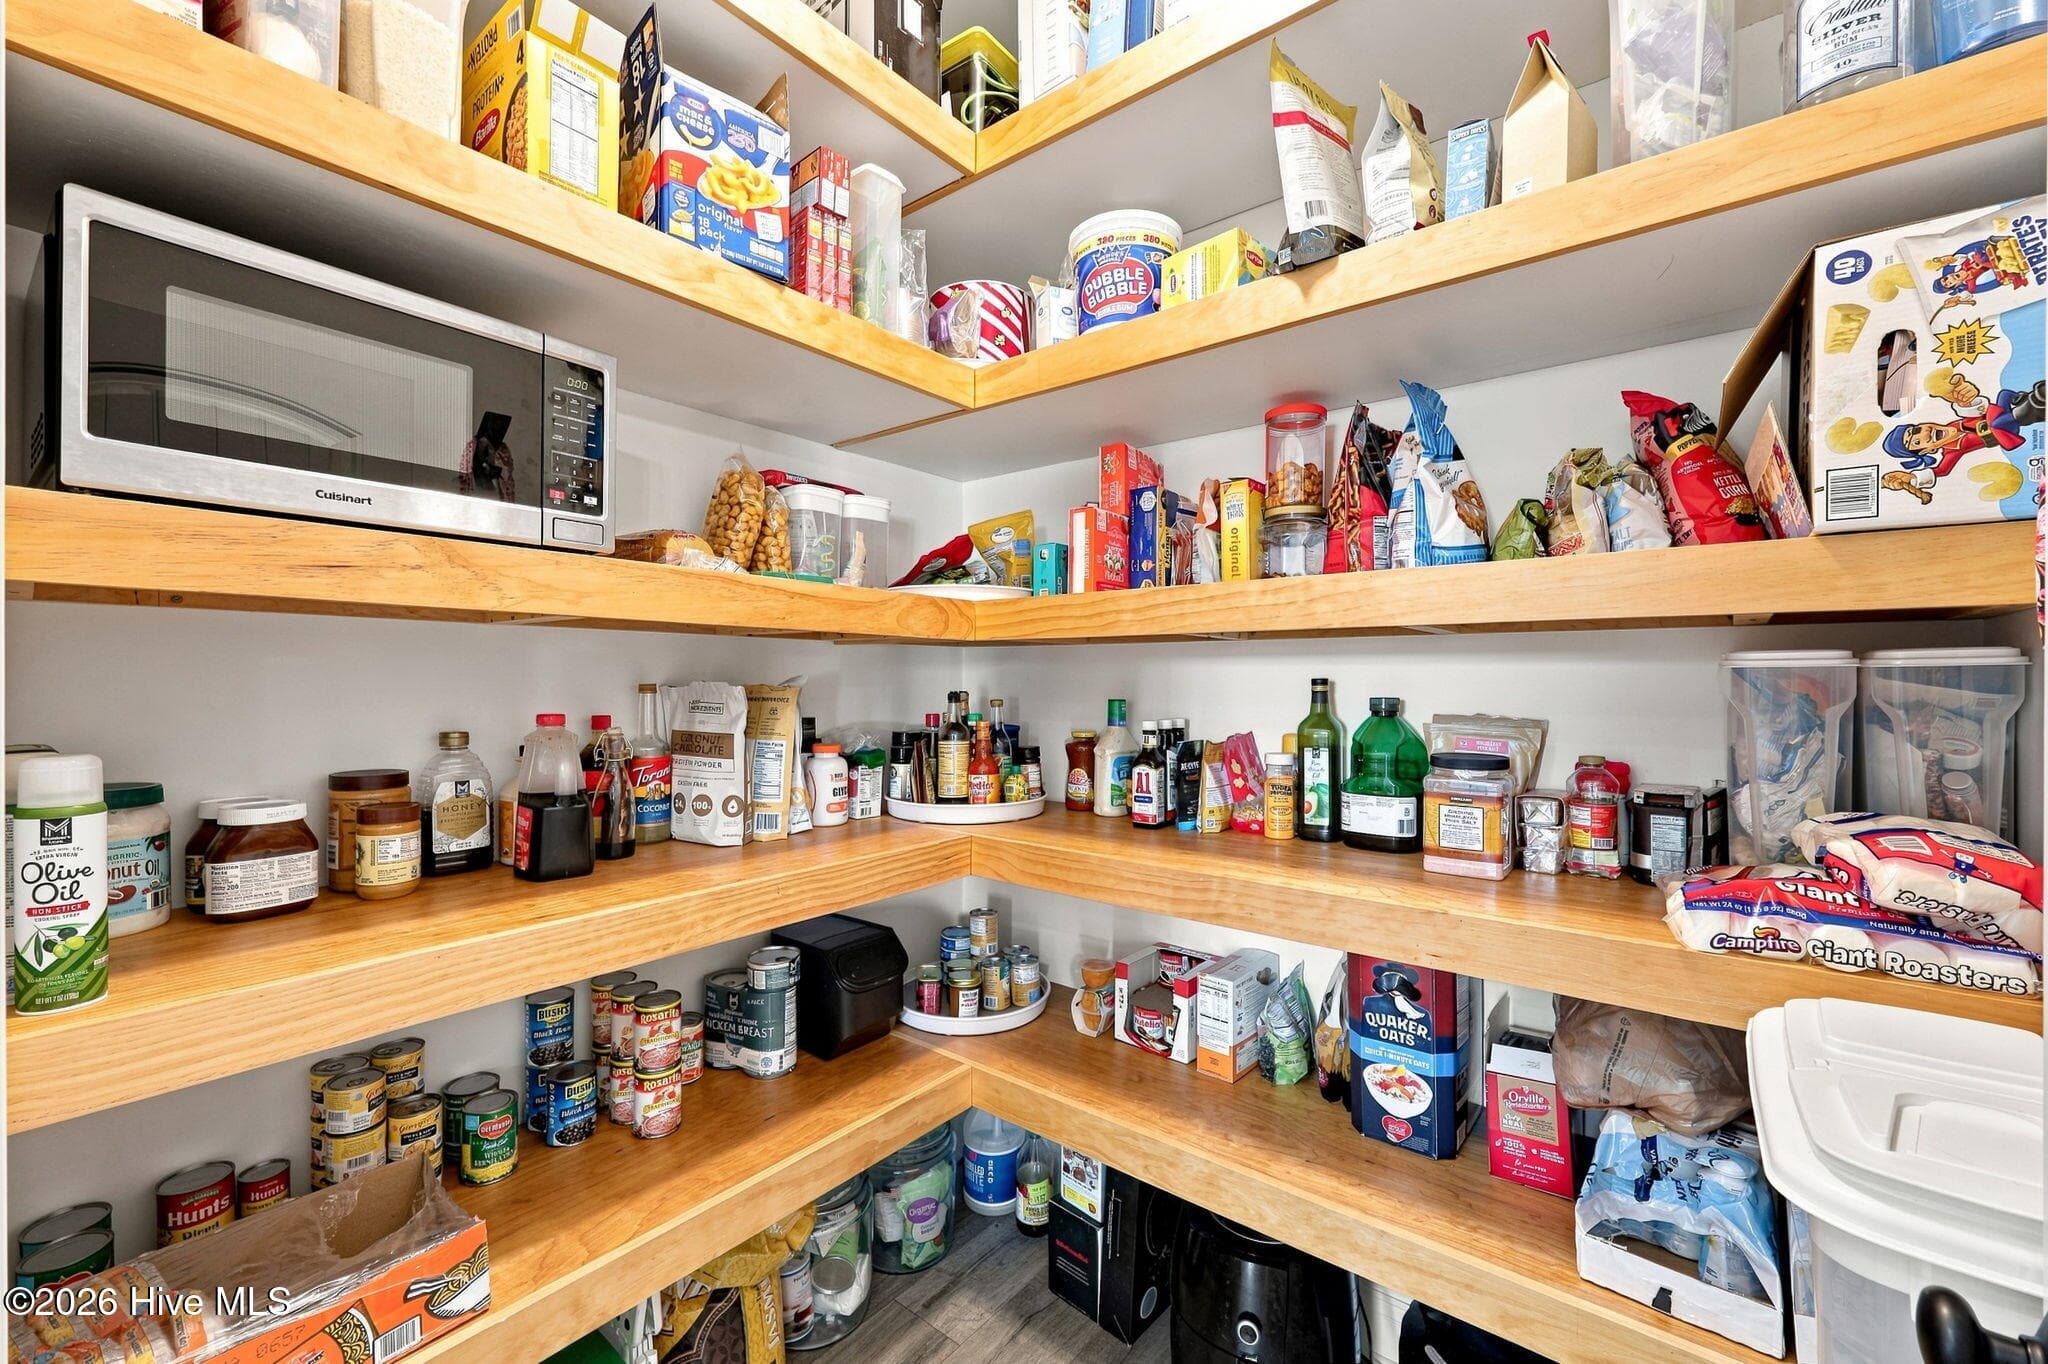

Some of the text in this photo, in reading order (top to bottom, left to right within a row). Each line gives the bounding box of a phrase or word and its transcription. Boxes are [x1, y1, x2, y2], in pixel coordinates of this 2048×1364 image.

[1812, 13, 1882, 46] SILVER
[516, 39, 525, 65] 4
[472, 73, 505, 120] PROTEIN+
[680, 106, 702, 121] mac
[475, 114, 498, 147] Barilla
[698, 204, 744, 229] original
[698, 216, 710, 227] 18
[699, 226, 726, 242] pack
[724, 222, 743, 235] flavor
[1097, 234, 1114, 246] 380
[1144, 234, 1160, 244] 380
[1834, 257, 1856, 279] 40
[1085, 267, 1145, 296] DUBBLE
[1088, 282, 1147, 309] BUBBLE
[314, 488, 373, 506] Cuisinart
[1231, 527, 1241, 579] original
[694, 760, 722, 769] POWDER
[633, 764, 671, 788] Toran
[442, 802, 482, 813] HONEY
[21, 861, 95, 885] Olive
[145, 859, 160, 876] Oil
[32, 880, 84, 905] Oil
[1774, 880, 1860, 907] Giant
[32, 902, 83, 916] NON STICK
[1869, 921, 1940, 938] Naturally and
[1711, 933, 1801, 953] Campfire
[1805, 938, 2028, 995] Giant Roasters
[538, 1004, 571, 1020] BUSH'S
[640, 1008, 680, 1023] Rosarita
[534, 1029, 552, 1038] Black
[738, 1025, 774, 1039] BREAST
[1365, 1012, 1429, 1040] QUAKER
[1380, 1028, 1415, 1046] OATS
[643, 1071, 681, 1092] Rosarita
[1509, 1091, 1545, 1104] Orville
[562, 1108, 581, 1118] Black
[909, 1203, 937, 1217] Organic
